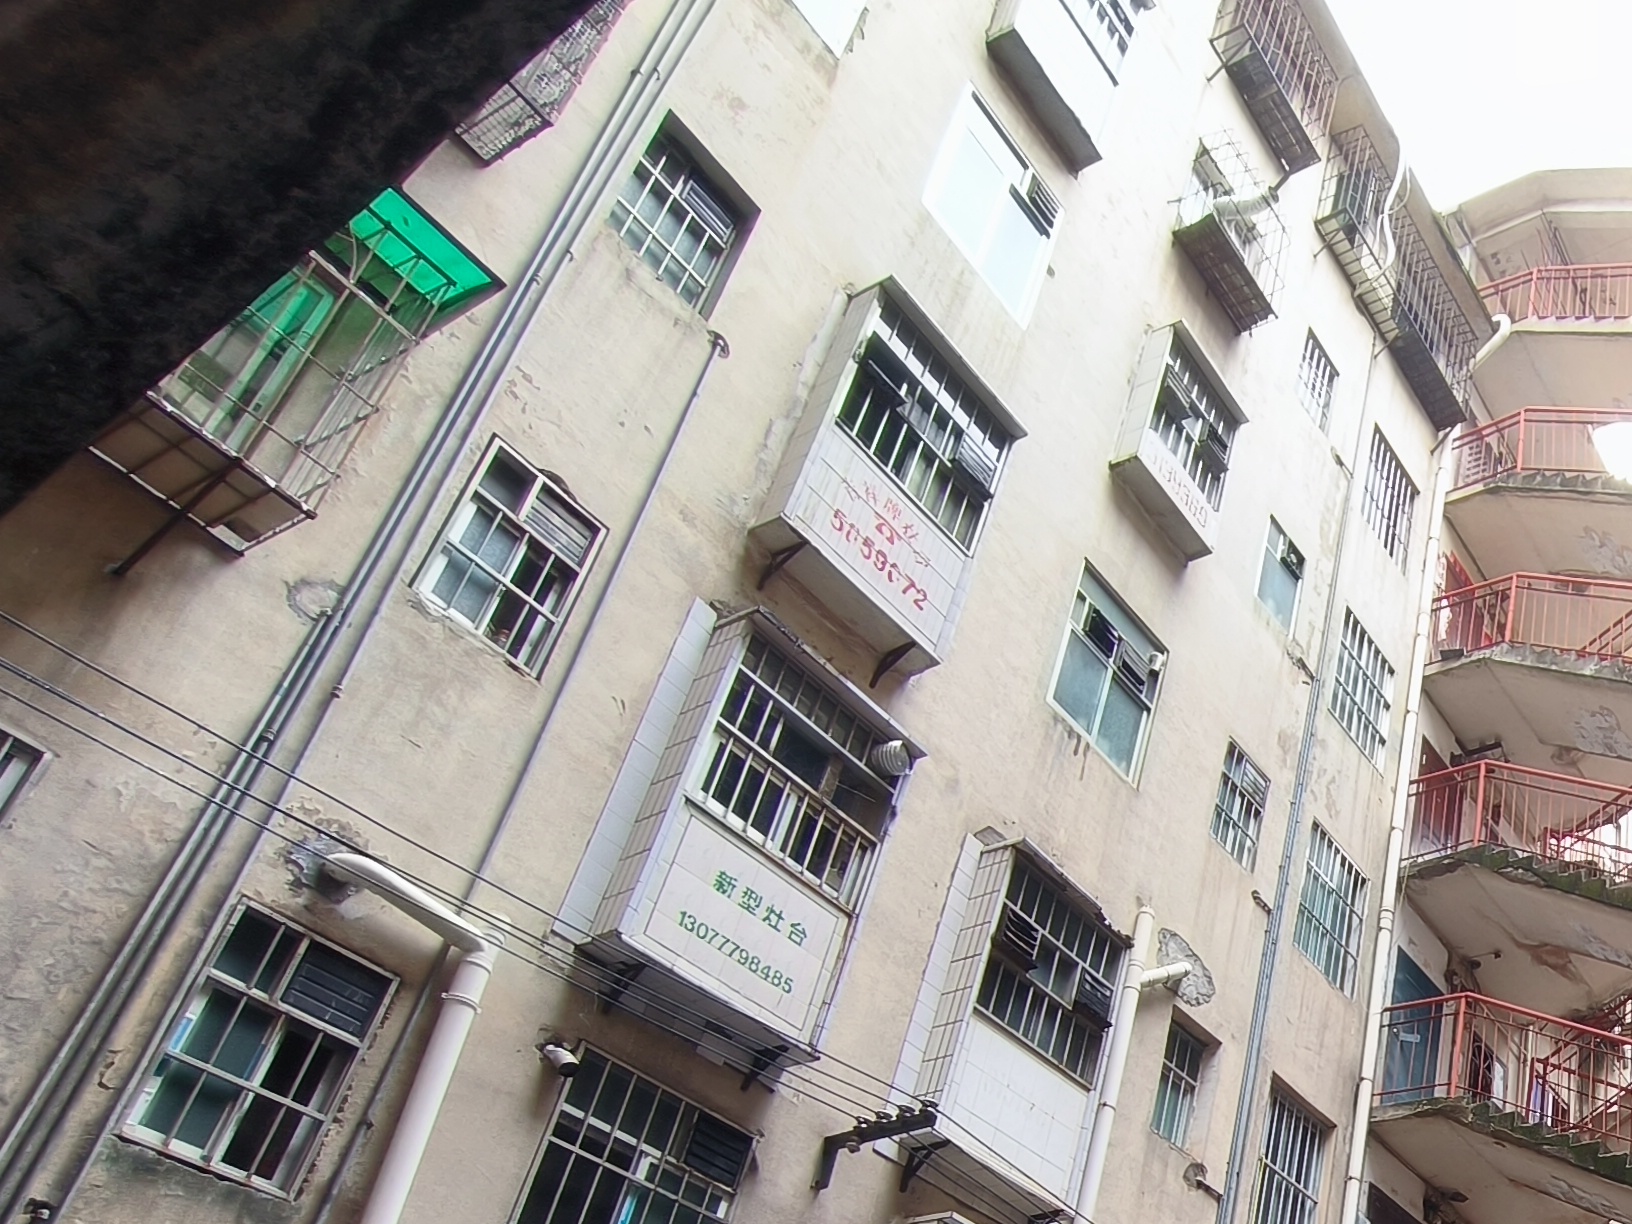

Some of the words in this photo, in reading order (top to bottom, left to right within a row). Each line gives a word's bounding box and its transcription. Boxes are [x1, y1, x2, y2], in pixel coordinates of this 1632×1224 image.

[713, 869, 808, 947] 新型灶台
[677, 910, 795, 994] 13077798485
